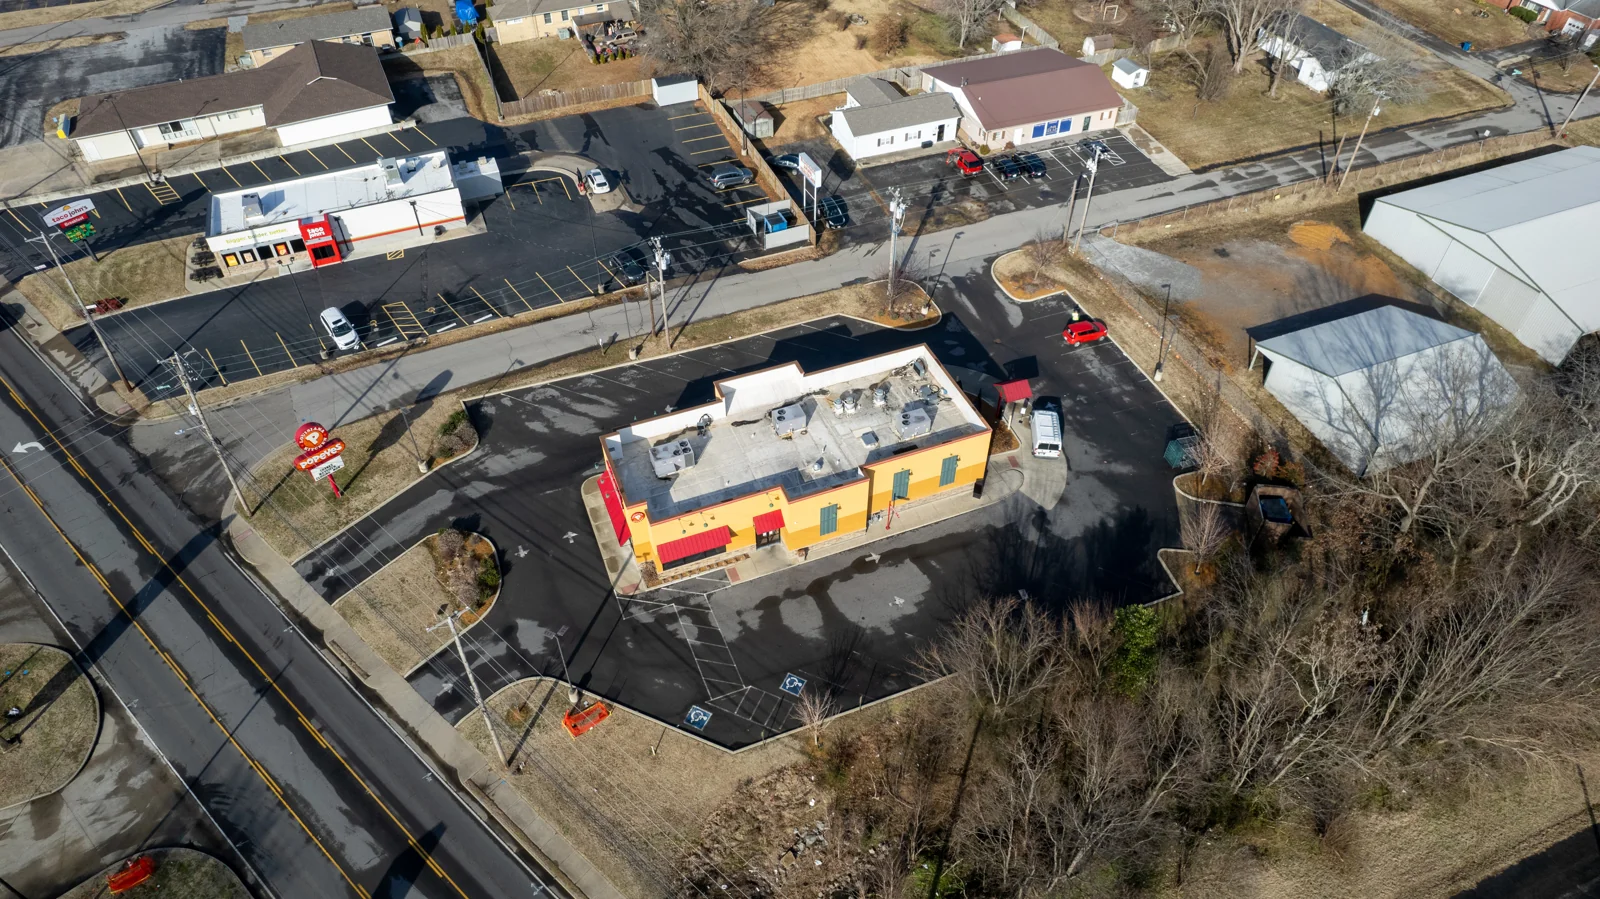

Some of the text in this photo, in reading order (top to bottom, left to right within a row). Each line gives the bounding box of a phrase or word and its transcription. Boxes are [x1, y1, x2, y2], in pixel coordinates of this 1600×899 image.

[52, 205, 88, 222] taco john's
[307, 226, 324, 234] taco
[299, 426, 325, 444] LOUISIANA
[303, 437, 328, 452] KITCHEN
